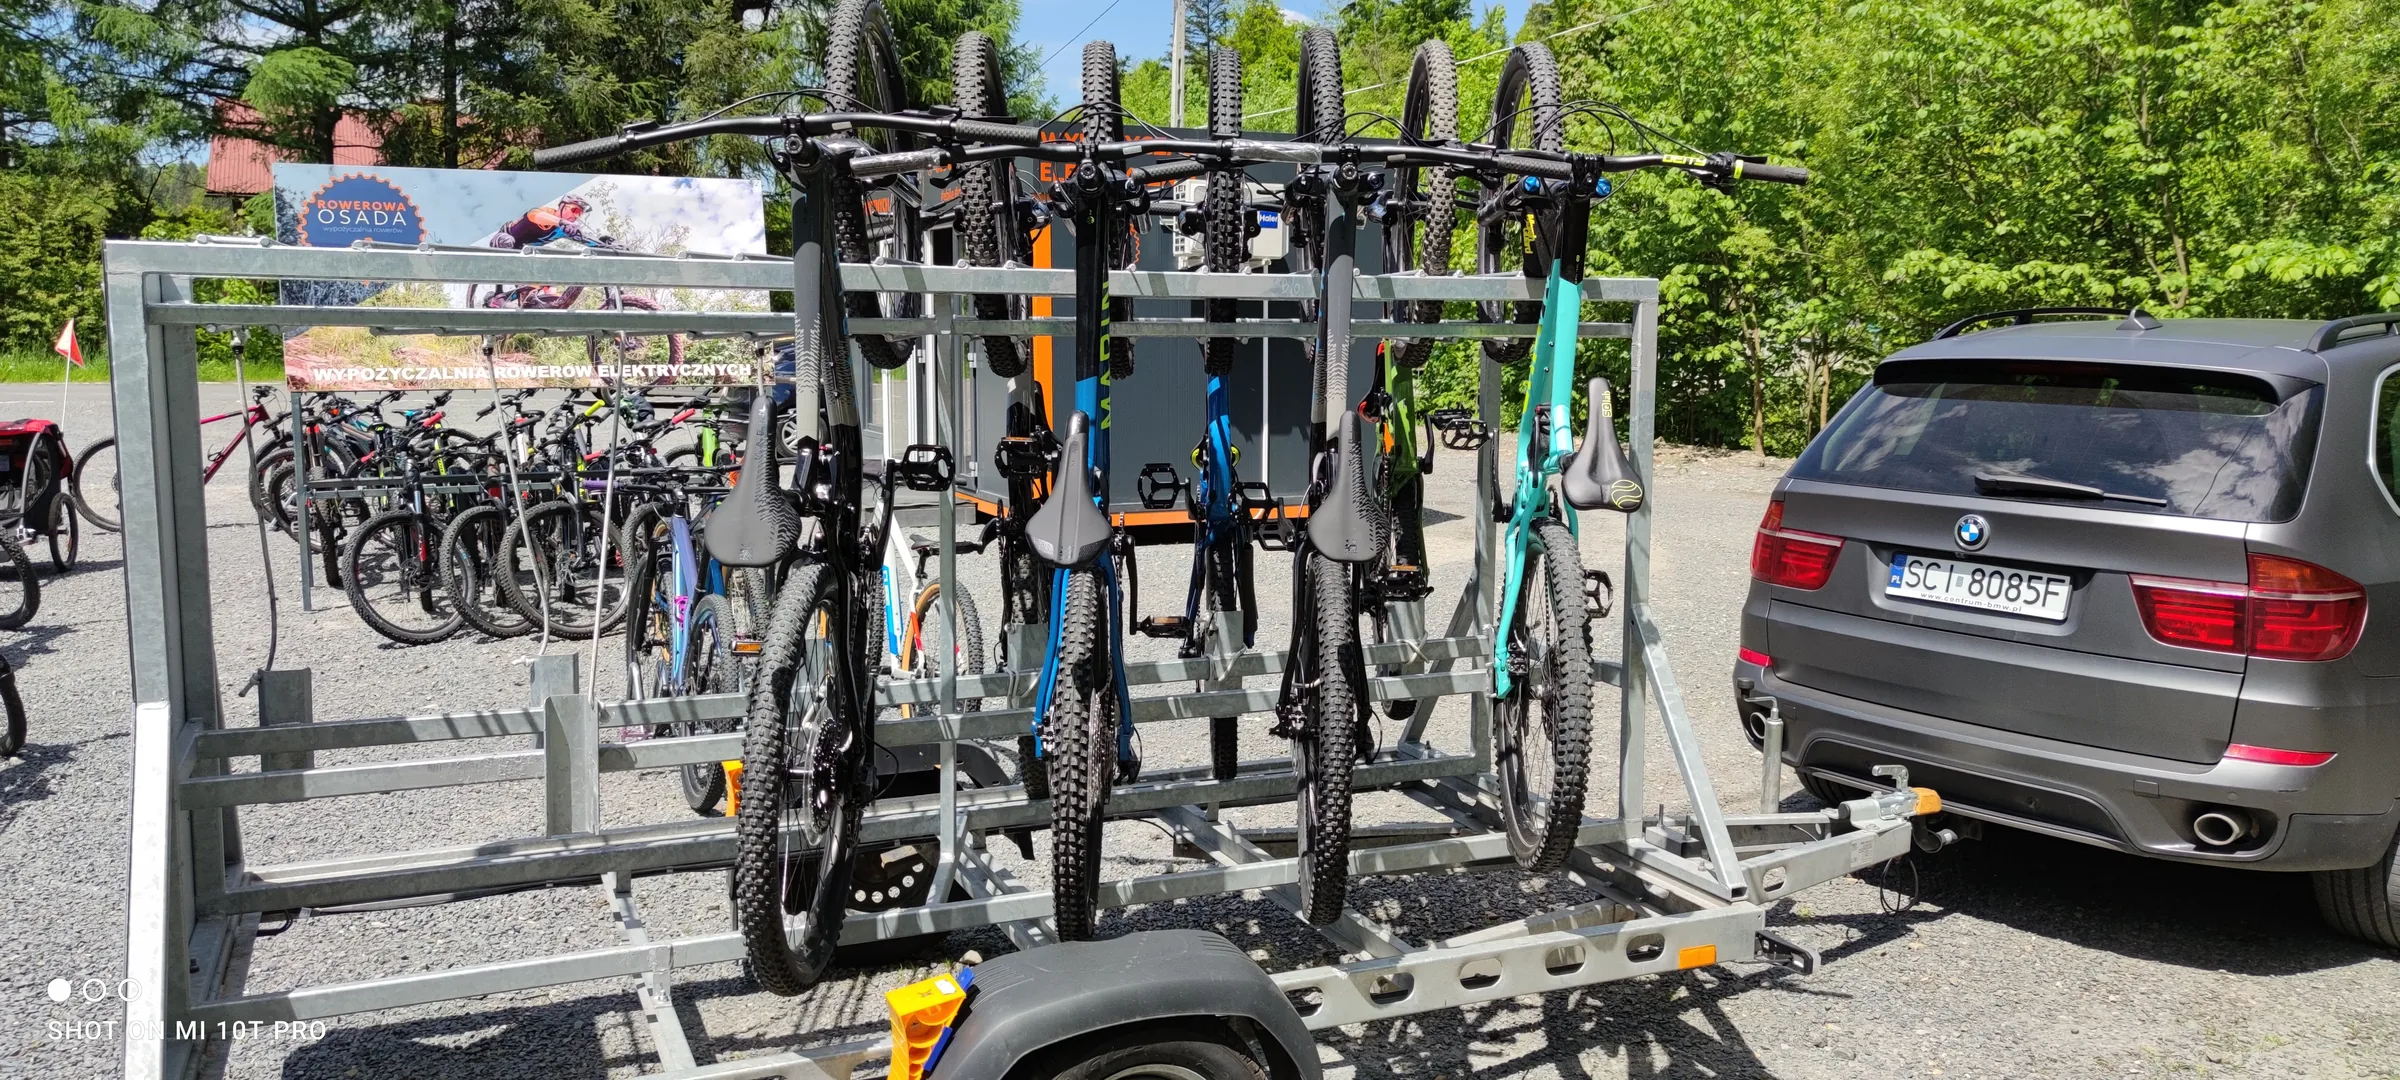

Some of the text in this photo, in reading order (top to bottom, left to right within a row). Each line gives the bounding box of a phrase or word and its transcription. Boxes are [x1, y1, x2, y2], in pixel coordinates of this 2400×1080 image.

[1662, 154, 1707, 167] DEITY
[317, 199, 407, 212] ROWEROWA
[317, 208, 407, 226] OSADA
[1259, 214, 1278, 223] Haier
[322, 226, 373, 234] wypożyczalnia
[313, 362, 752, 382] WYPOŻYCZALNIA ROWERÓW ELEKTRYCZNYCH
[1890, 575, 1902, 585] PL
[1905, 559, 2066, 607] SCI 8085F
[1920, 592, 2023, 613] www.centrum-bmw.pl
